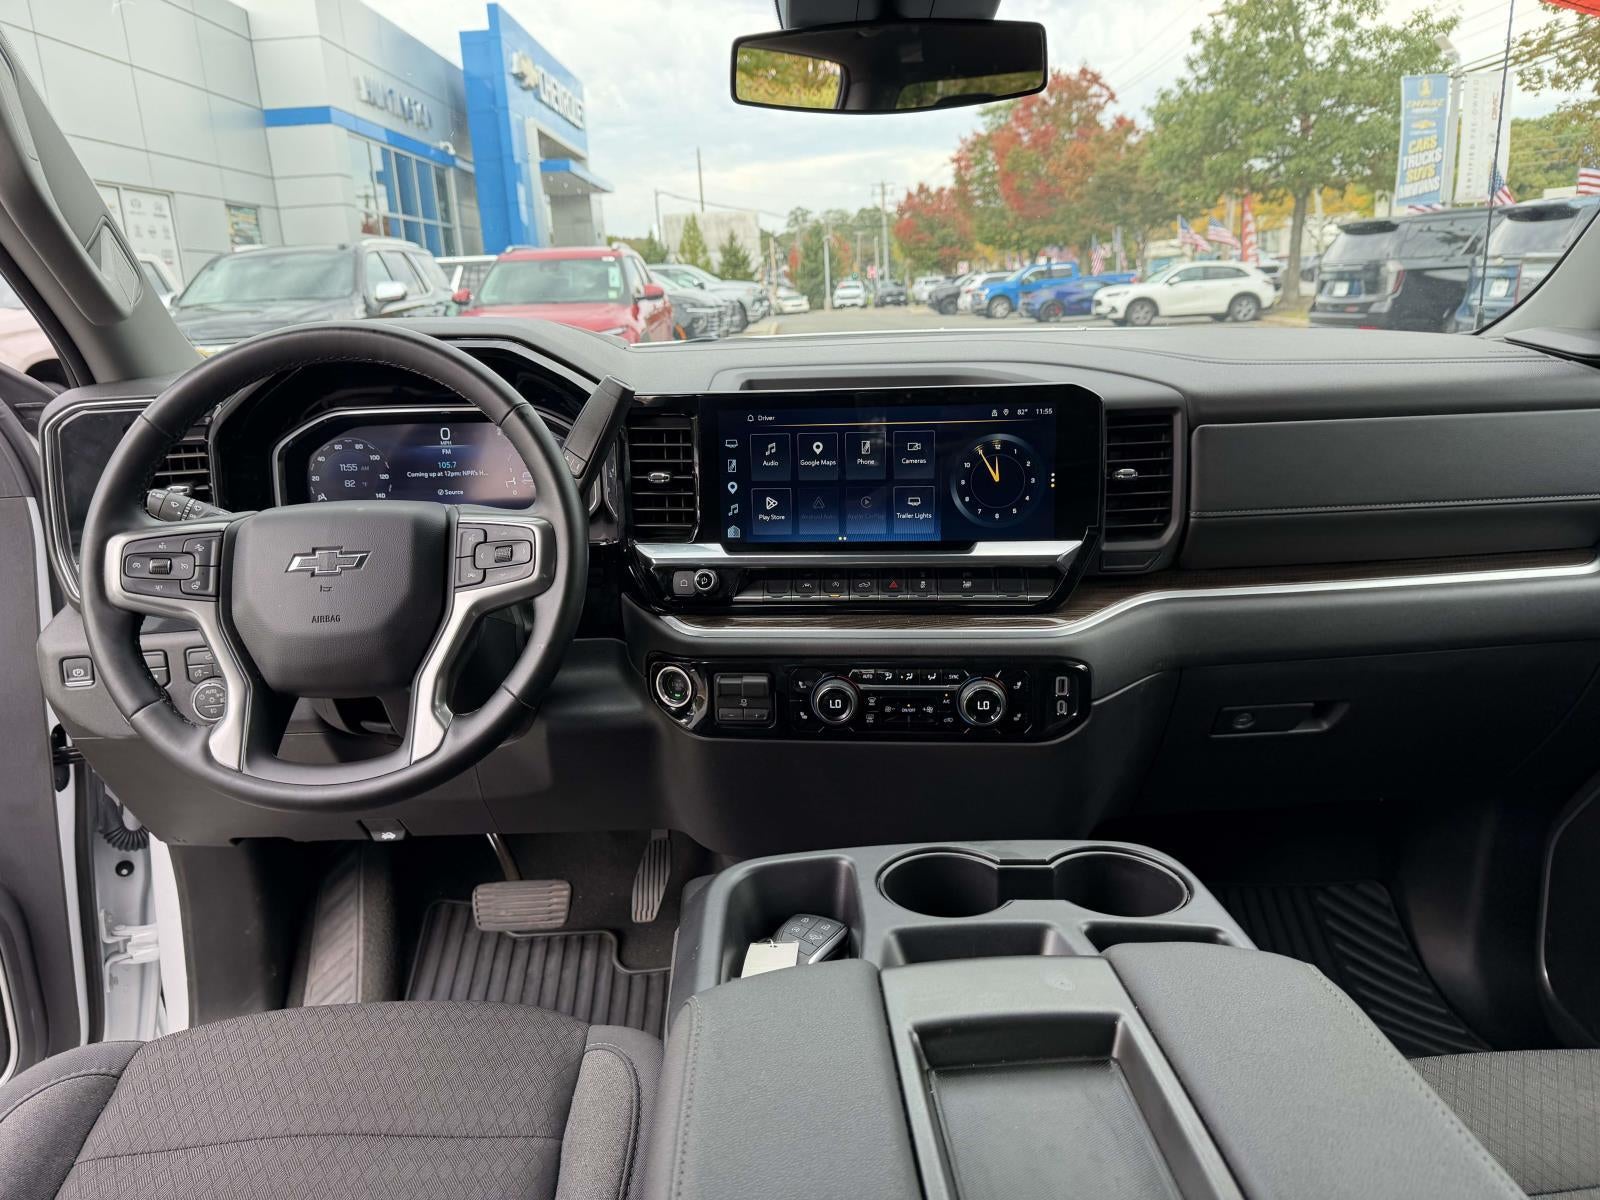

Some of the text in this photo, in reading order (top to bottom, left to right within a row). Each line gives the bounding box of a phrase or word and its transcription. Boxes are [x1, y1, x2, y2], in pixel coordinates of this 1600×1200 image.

[1408, 134, 1438, 154] CARS
[1403, 147, 1442, 171] TRUCKS
[440, 427, 451, 440] 0
[340, 463, 358, 471] 11:55
[438, 461, 457, 469] 105.7
[406, 471, 429, 479] Coming
[344, 479, 356, 488] 82
[758, 514, 770, 522] Play
[915, 512, 932, 520] Lights
[311, 614, 341, 624] AIRBAG
[829, 699, 842, 709] LO
[977, 700, 990, 710] LO
